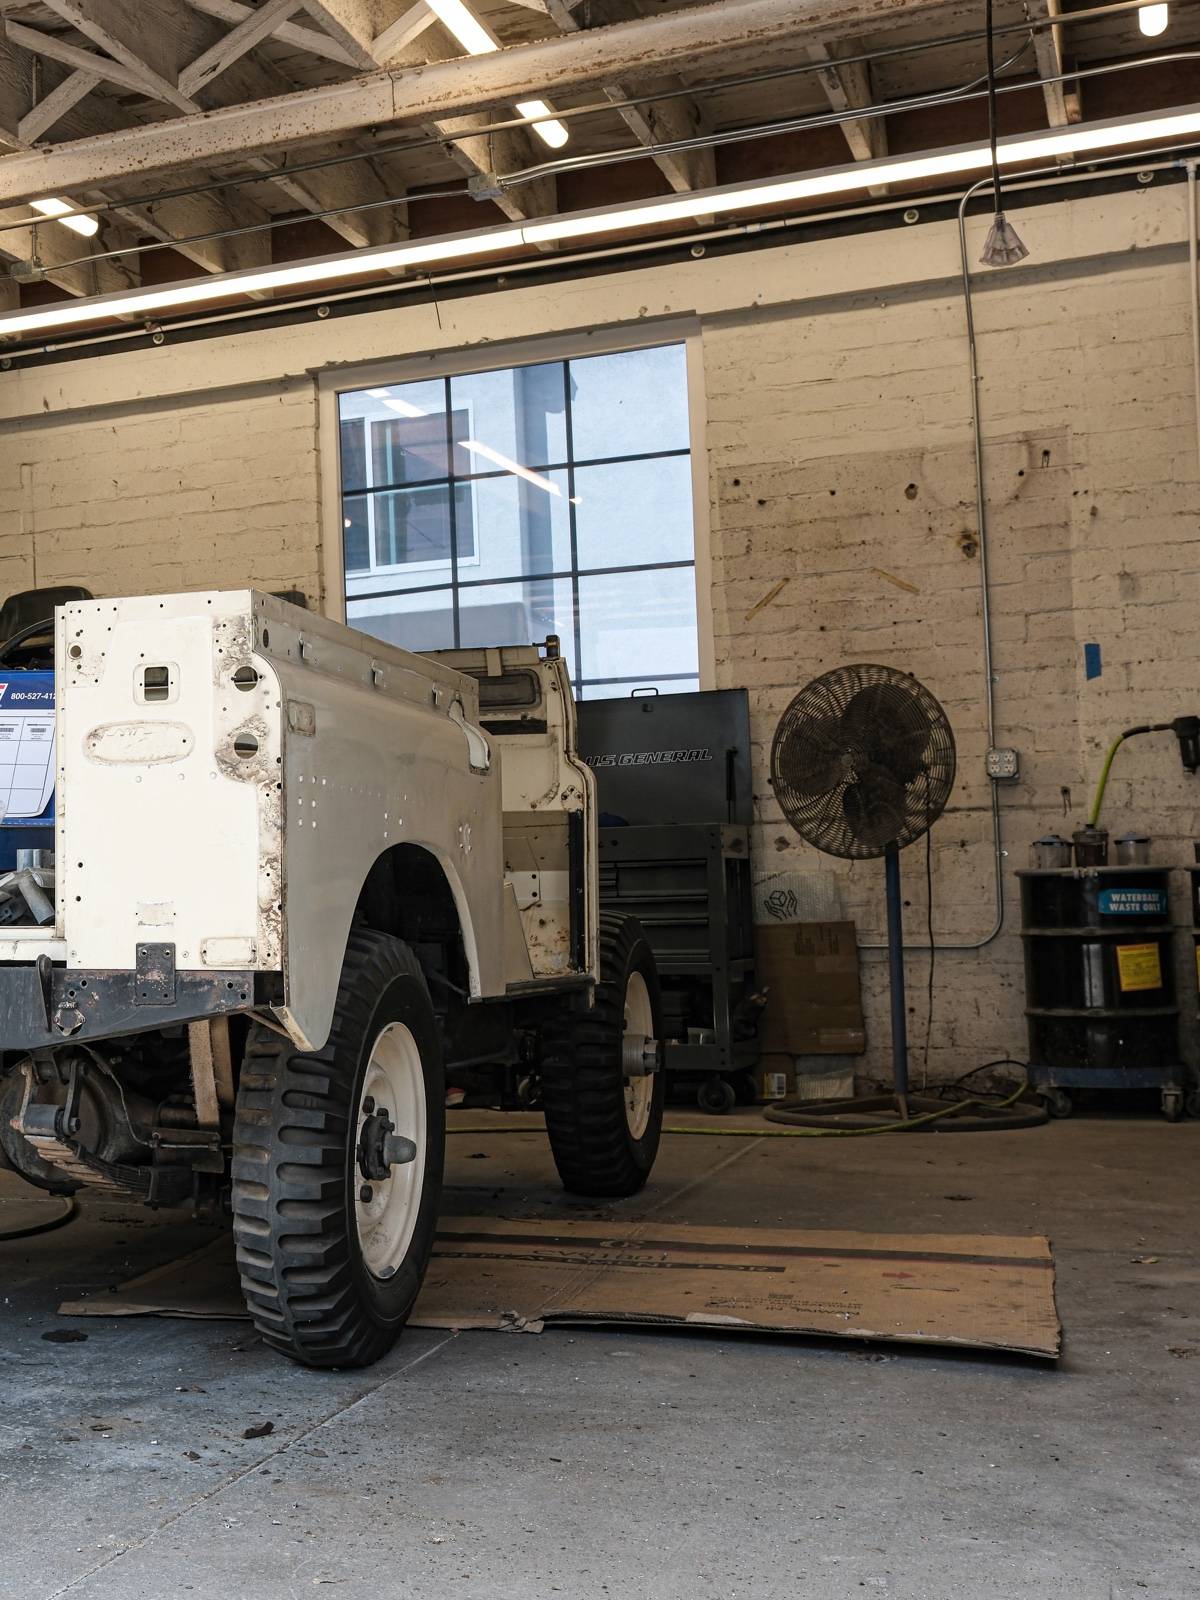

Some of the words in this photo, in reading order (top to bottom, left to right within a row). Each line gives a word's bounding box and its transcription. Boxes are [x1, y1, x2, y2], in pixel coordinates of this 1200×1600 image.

[619, 749, 712, 766] GENERAL
[1109, 903, 1141, 912] WASTE
[1142, 903, 1161, 912] ONLY
